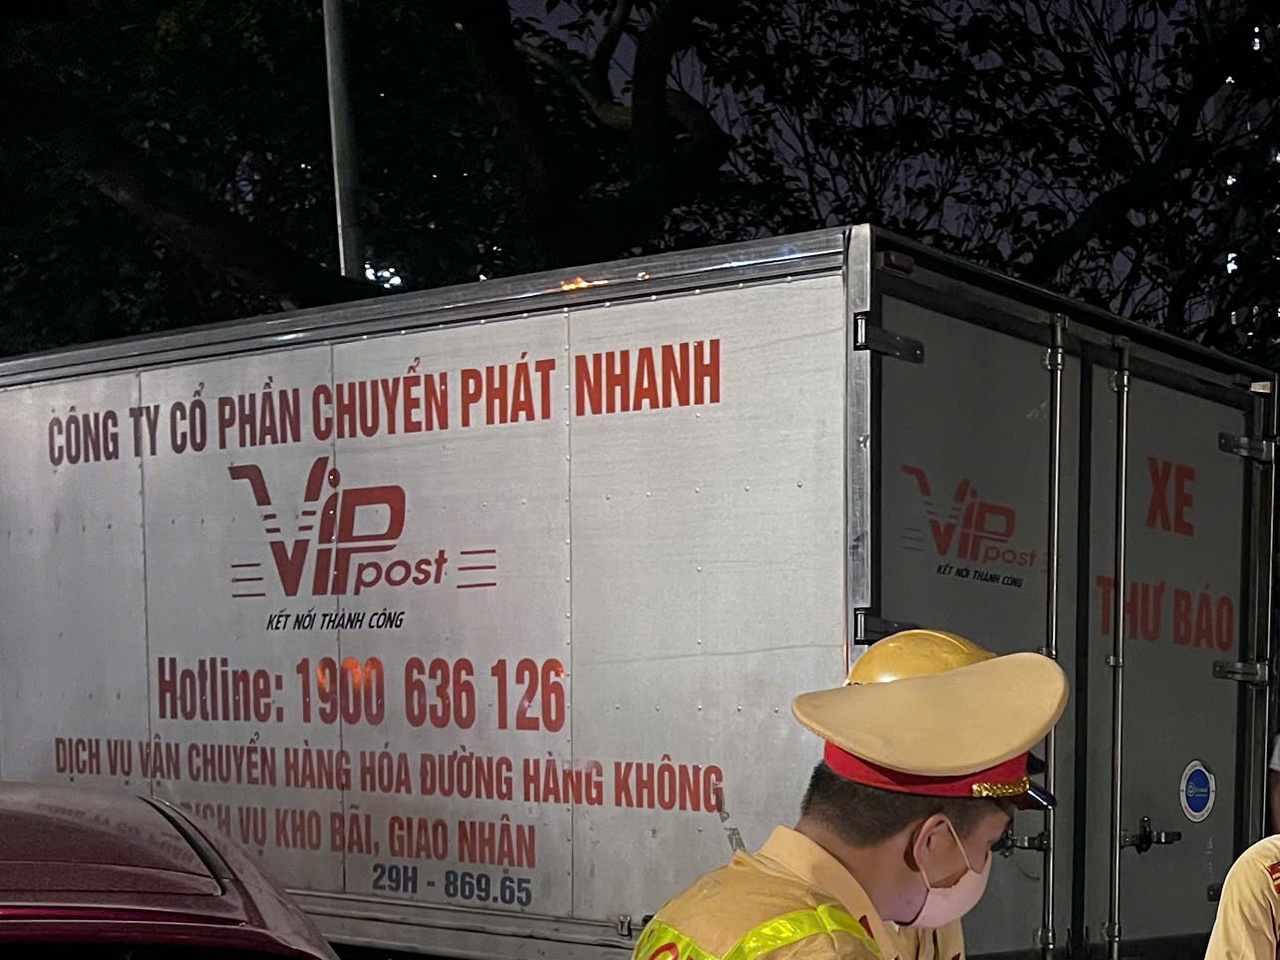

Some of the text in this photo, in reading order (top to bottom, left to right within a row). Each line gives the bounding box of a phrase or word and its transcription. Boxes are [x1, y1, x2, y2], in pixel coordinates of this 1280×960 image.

[49, 339, 720, 466] CÔNG TY CỔ PHẦN CHUYỂN PHÁT NHANH
[1145, 456, 1196, 537] XE
[353, 549, 448, 596] post
[266, 606, 405, 630] KẾT NỐI THÀNH CÔNG
[1096, 575, 1235, 652] THƯ BÁO
[157, 656, 566, 732] Hotline: 1900 636 126
[55, 731, 723, 813] DỊCH VỤ VẬN CHUYỂN HÀNG HÓA ĐƯỜNG HÀNG KHÔNG
[238, 806, 267, 856] VỤ
[275, 808, 321, 850] KHO
[330, 804, 379, 856] BÃI,
[388, 816, 448, 861] GIAO
[457, 814, 536, 875] NHẬN
[372, 863, 418, 894] 29H
[444, 870, 532, 907] 869.65
